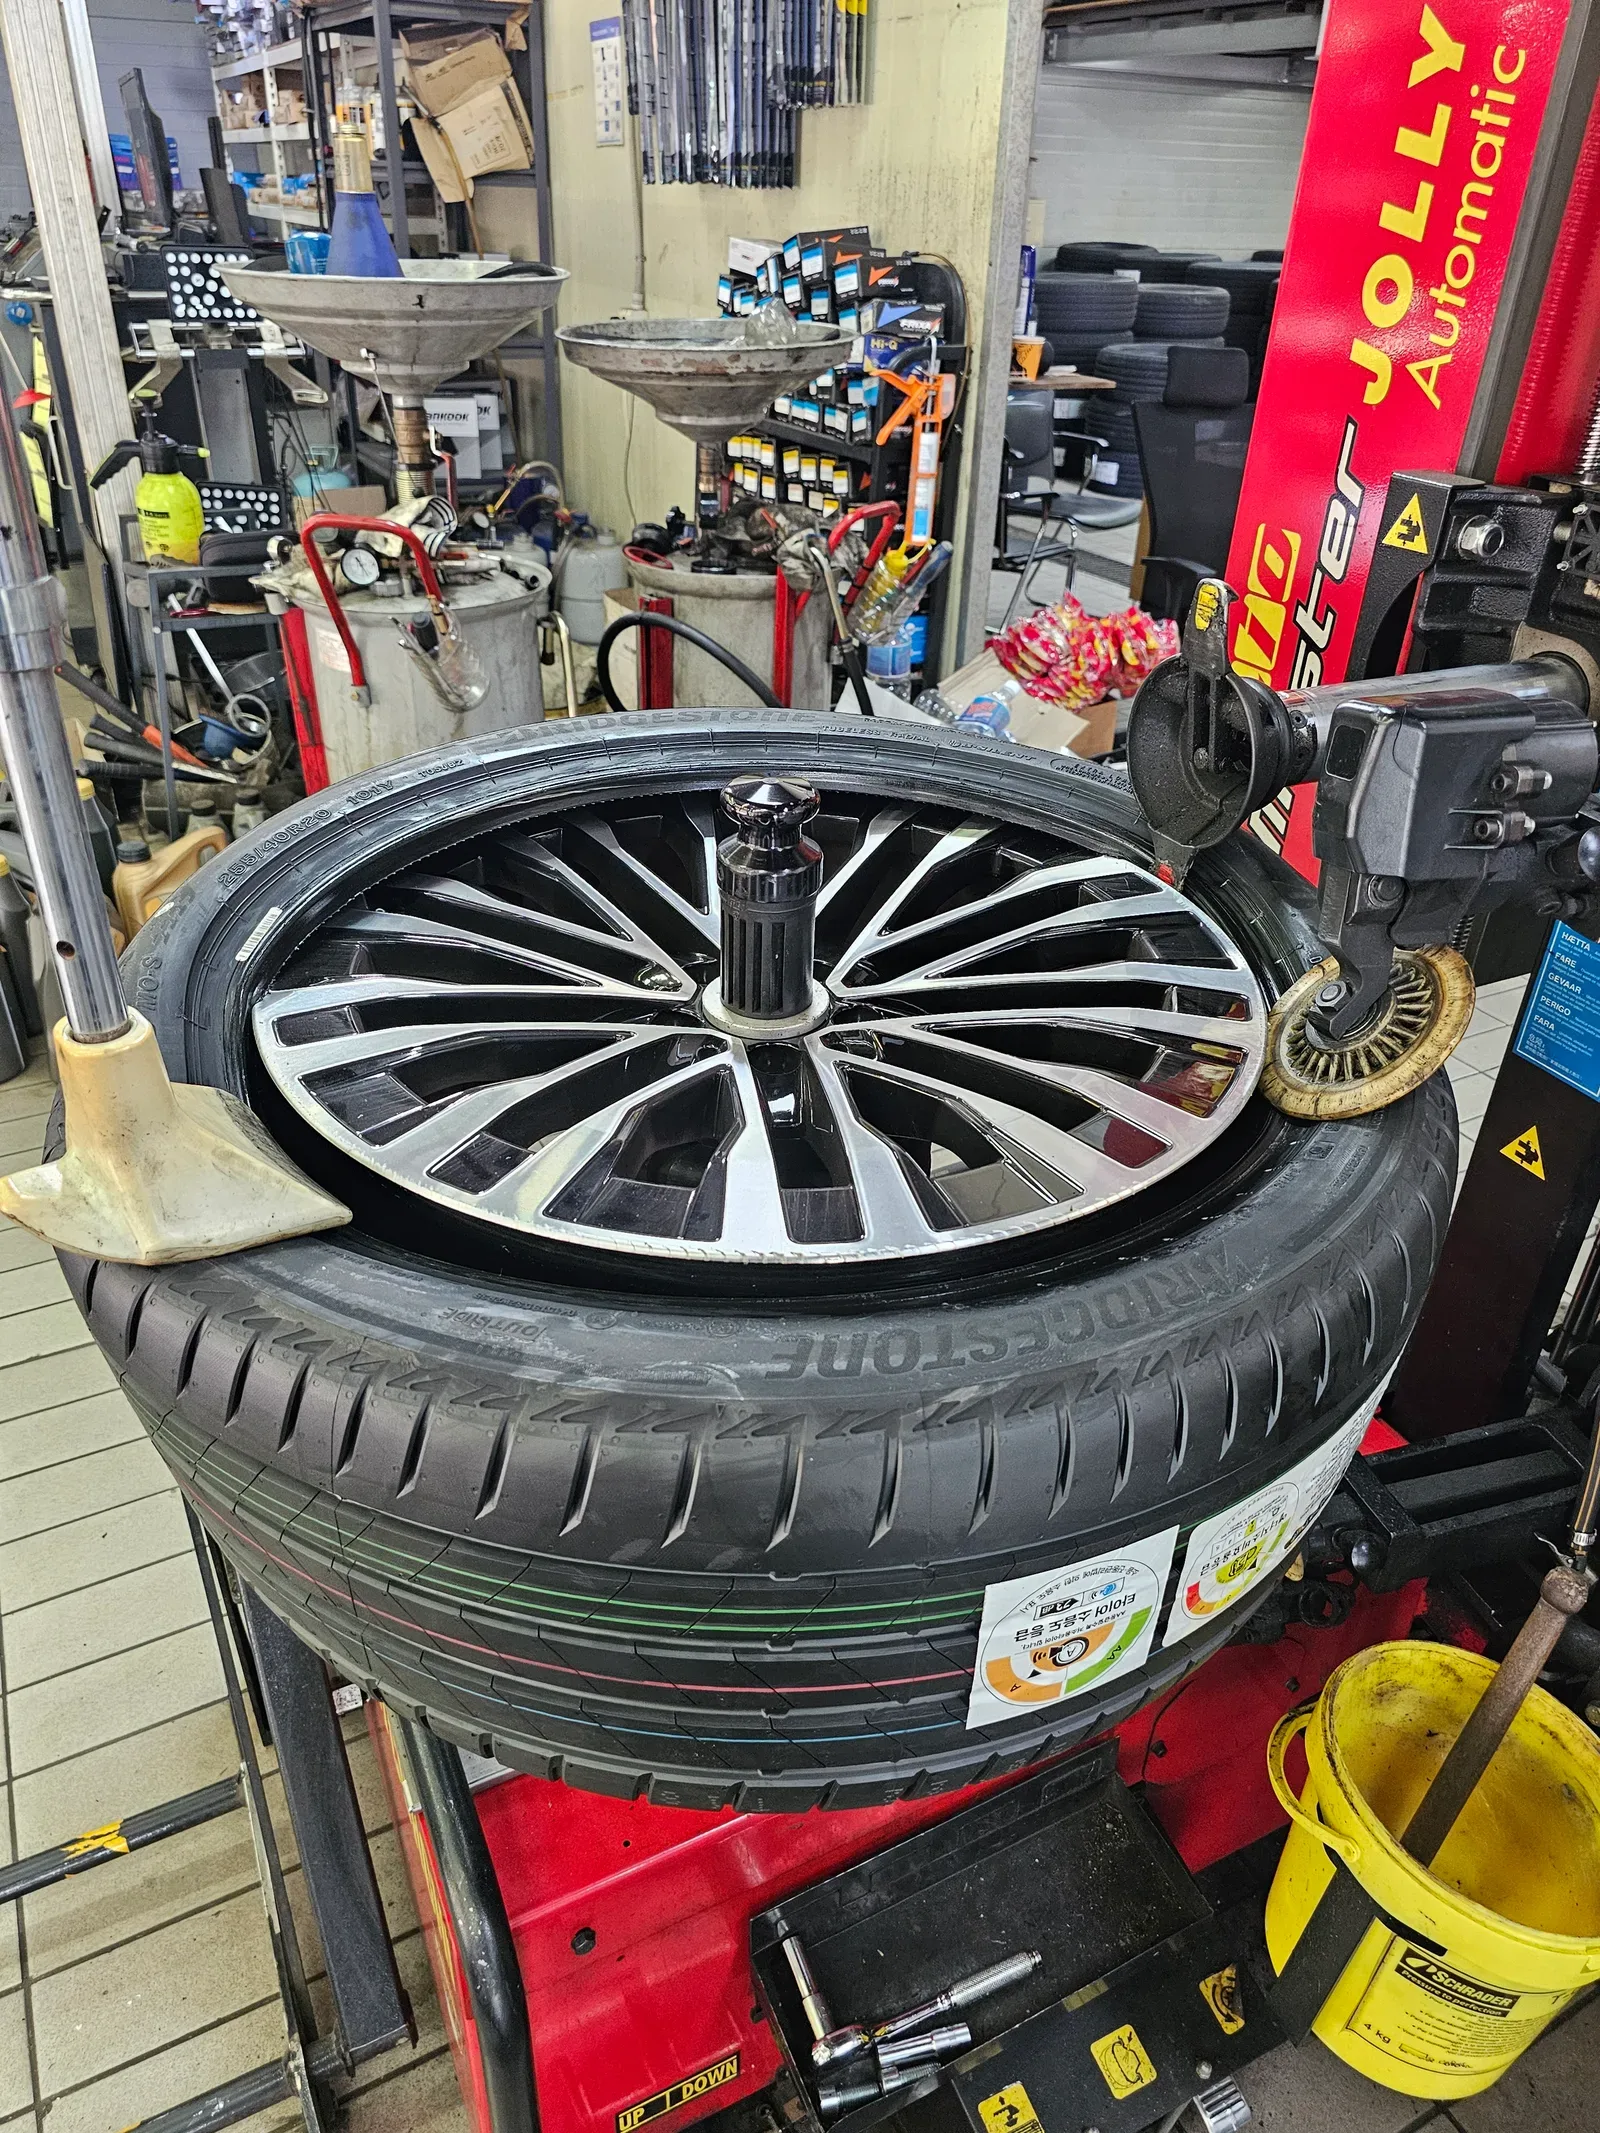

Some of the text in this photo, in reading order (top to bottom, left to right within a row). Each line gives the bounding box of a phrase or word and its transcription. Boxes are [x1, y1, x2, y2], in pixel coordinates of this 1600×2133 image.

[1350, 4, 1465, 405] JOLLY
[1405, 44, 1527, 410] Automatic
[1247, 415, 1365, 856] mster
[217, 807, 333, 887] 255/40R20
[345, 778, 395, 806] 101Y
[1561, 931, 1591, 952] HÆTTA
[1554, 952, 1577, 968] FARE
[1548, 972, 1582, 994] GEVAAR
[1540, 995, 1571, 1016] PERIGO
[1534, 1014, 1555, 1031] FARA
[1014, 1592, 1136, 1643] 타이어 소음도 등급
[1066, 1646, 1078, 1658] A
[1106, 1644, 1122, 1660] AA
[1010, 1682, 1021, 1692] A
[1401, 1969, 1503, 2017] Pressure to perfection
[1430, 1969, 1513, 2007] SCHRADER
[1376, 2030, 1391, 2044] kg
[682, 2058, 738, 2100] DOWN
[619, 2107, 645, 2131] UP
